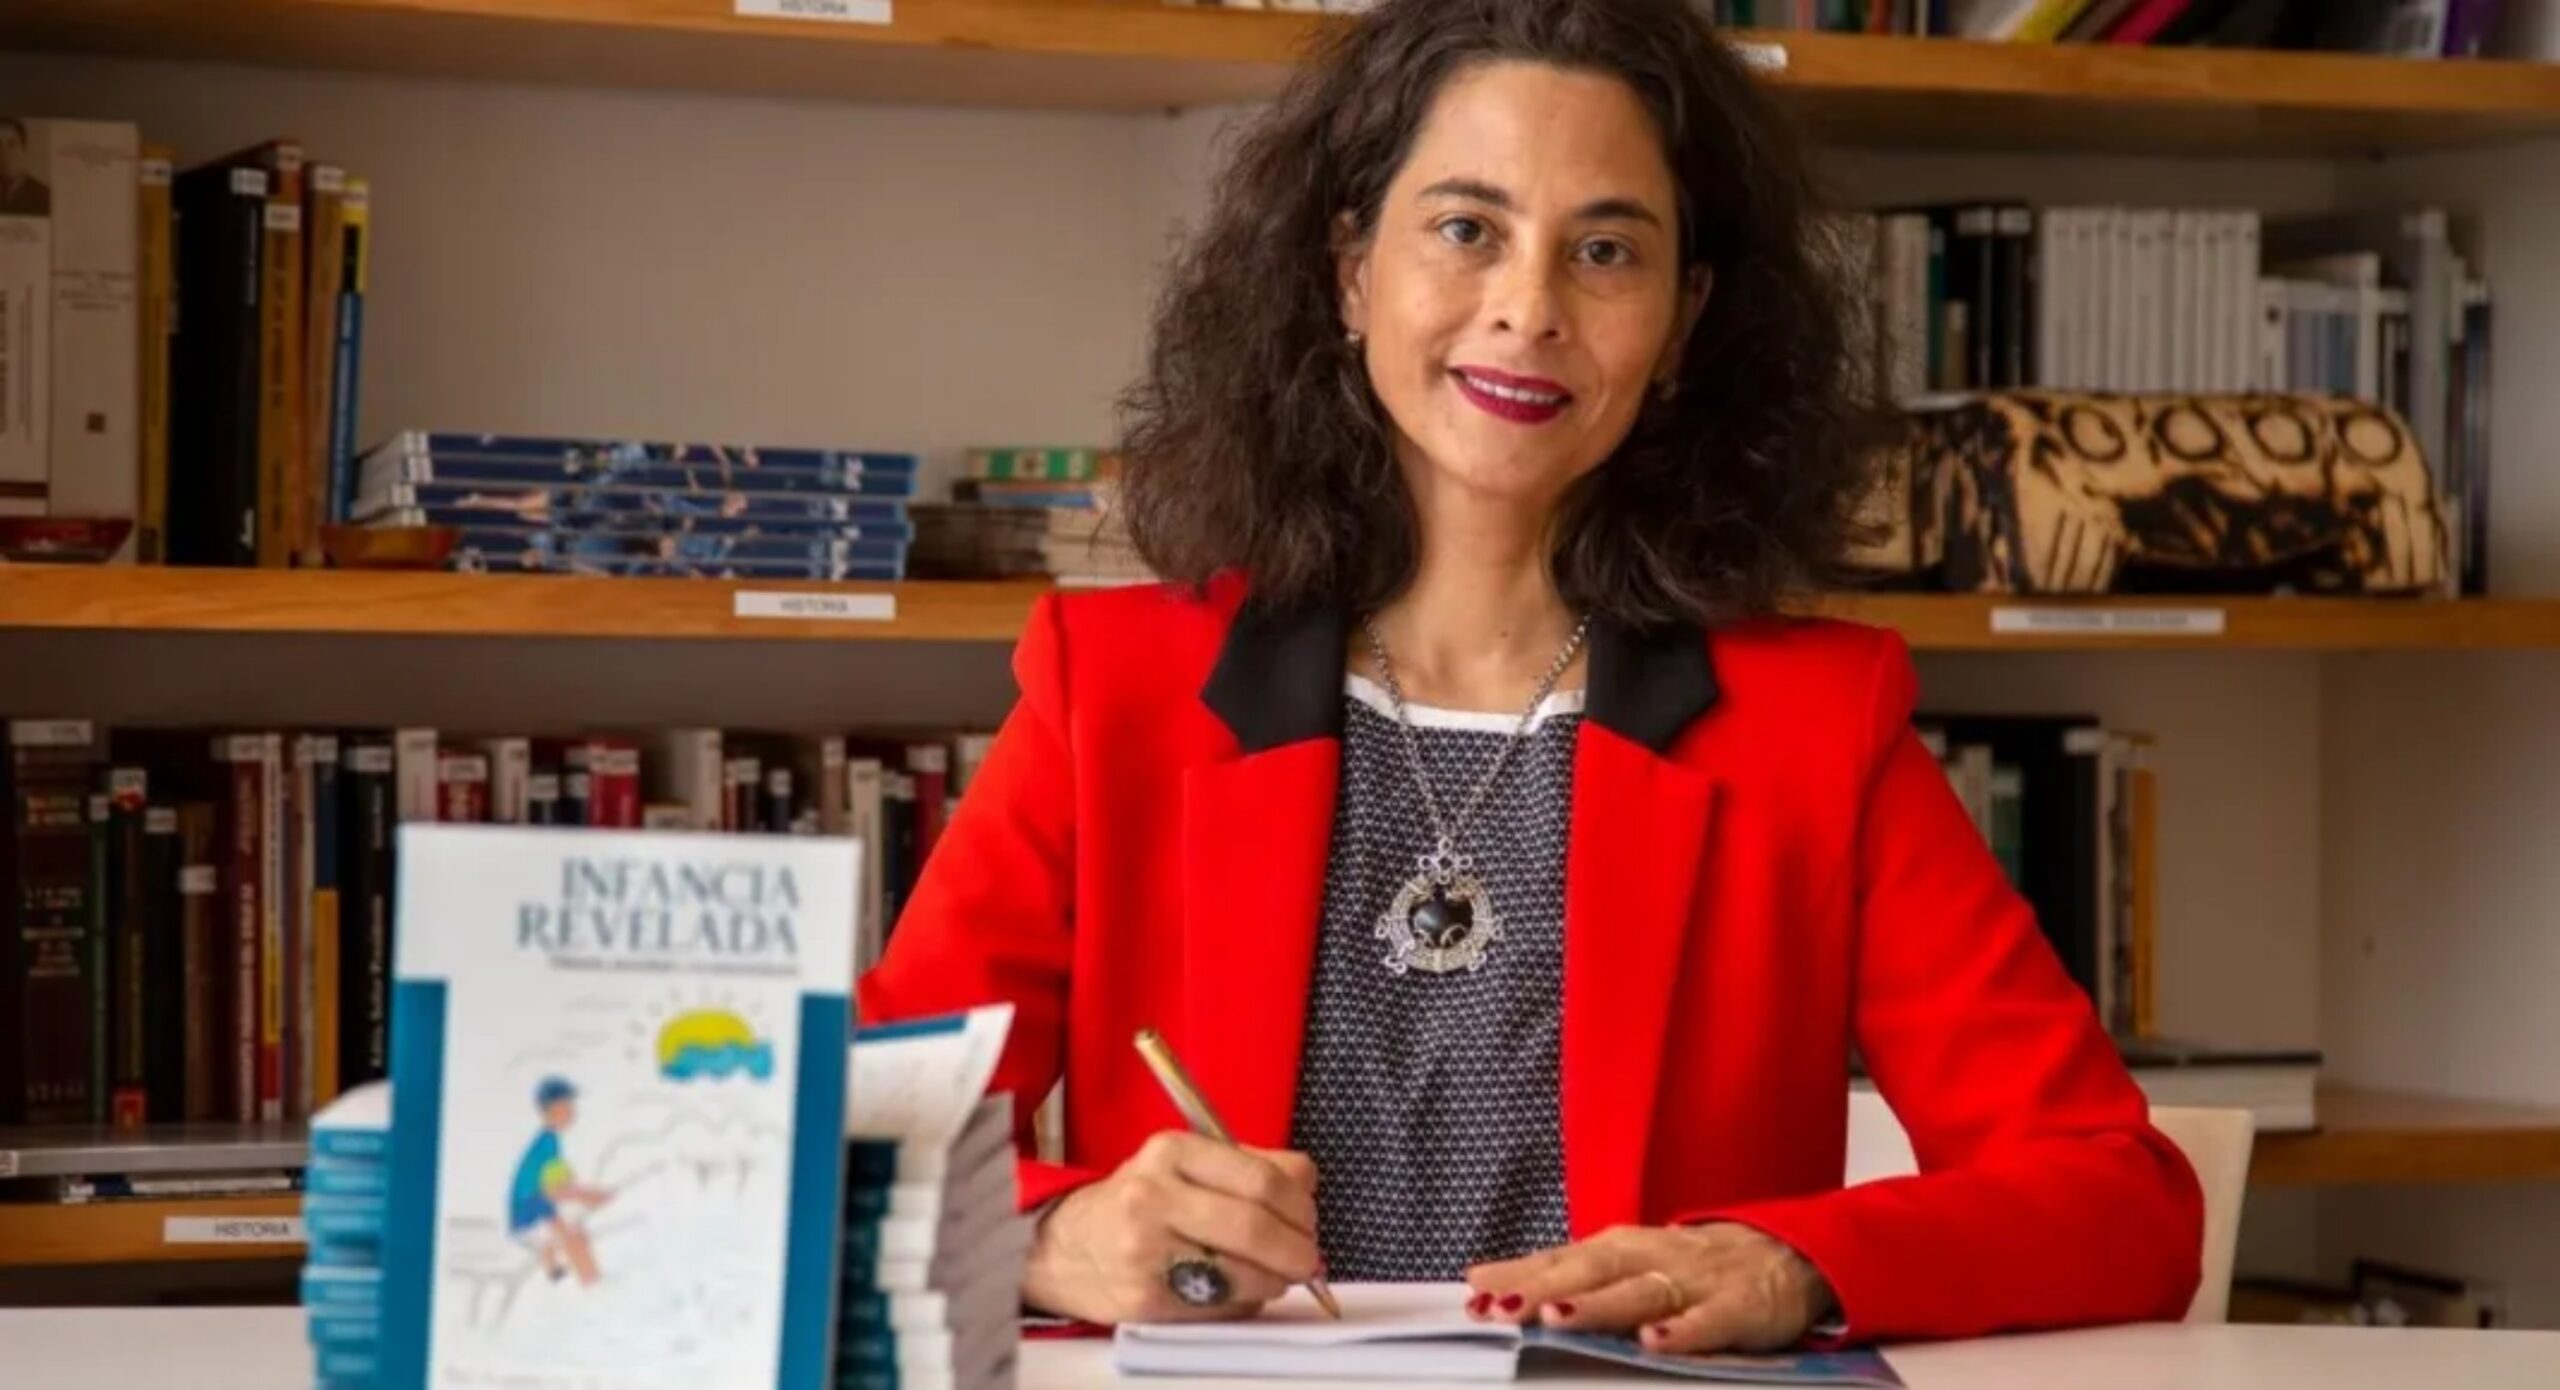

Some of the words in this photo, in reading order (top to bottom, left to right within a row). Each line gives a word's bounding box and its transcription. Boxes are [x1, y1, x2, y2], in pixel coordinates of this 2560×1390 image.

[560, 854, 800, 908] INFANCIA
[516, 900, 800, 956] REVELADA
[214, 1220, 291, 1237] HISTORIA
